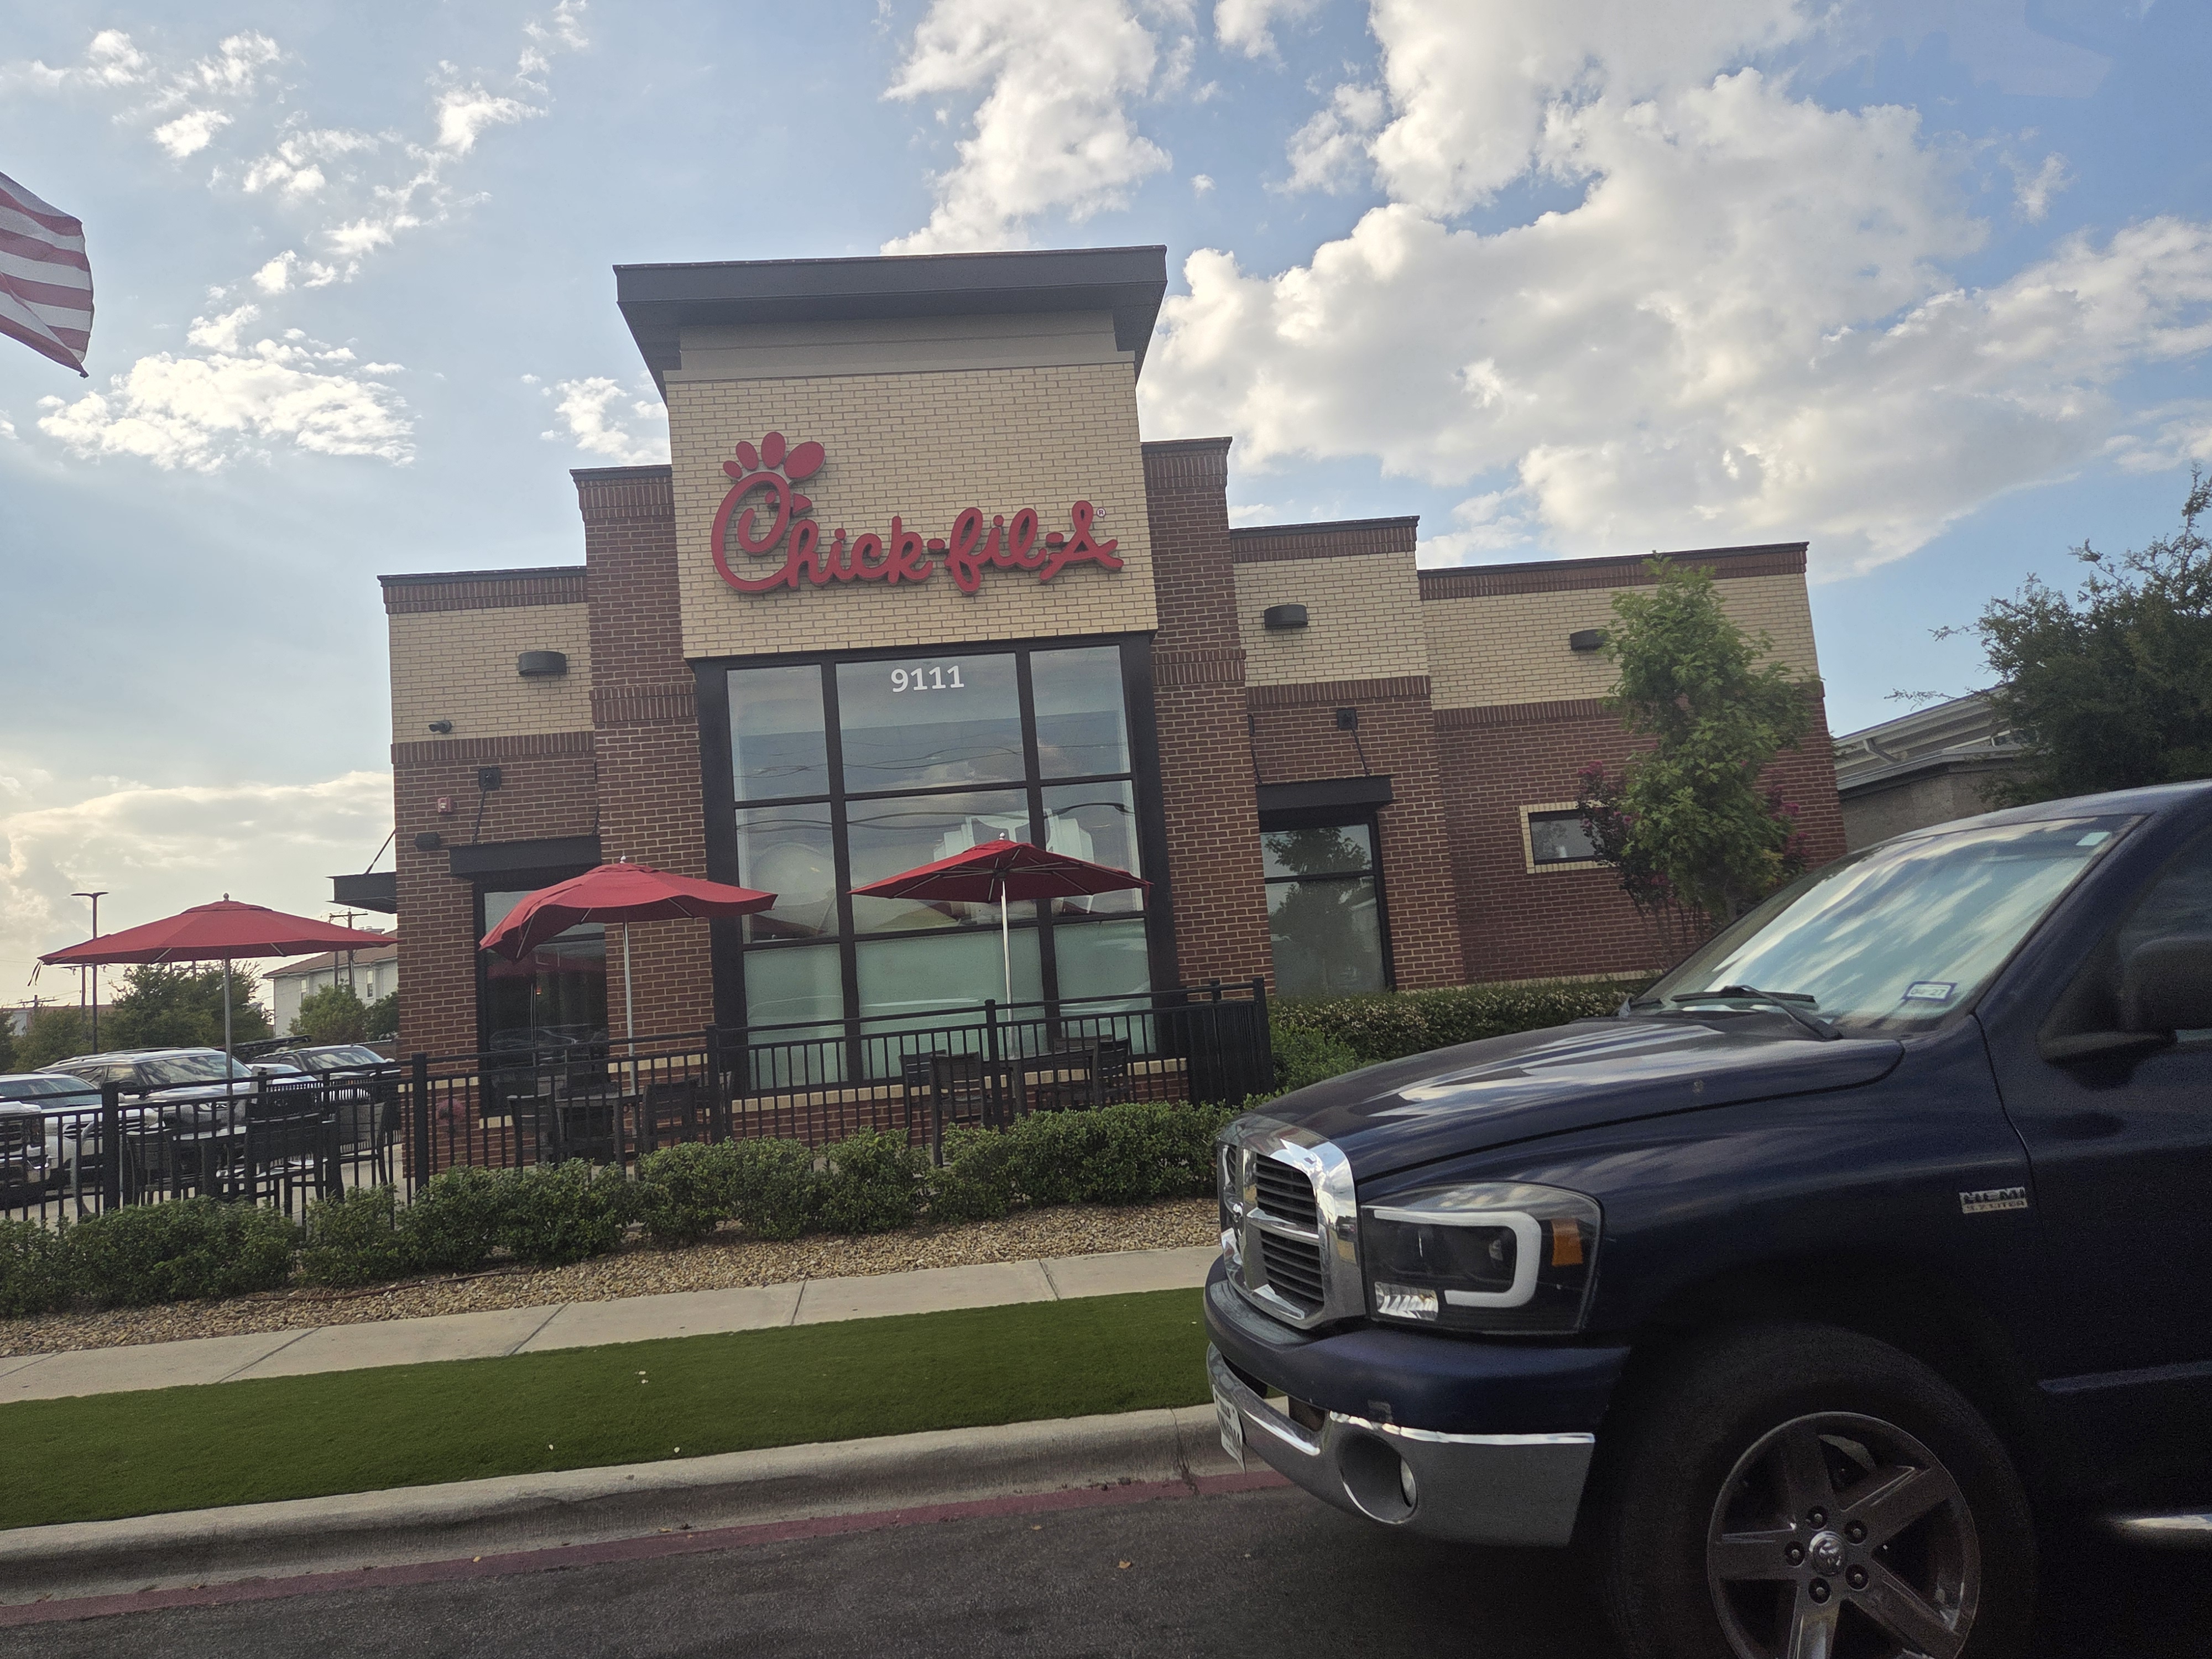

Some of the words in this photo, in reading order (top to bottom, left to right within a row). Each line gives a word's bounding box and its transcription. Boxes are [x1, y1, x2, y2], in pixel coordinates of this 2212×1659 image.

[711, 431, 1124, 595] Chick-fil-A
[891, 665, 964, 692] 9111
[1959, 1187, 2026, 1204] HEMI
